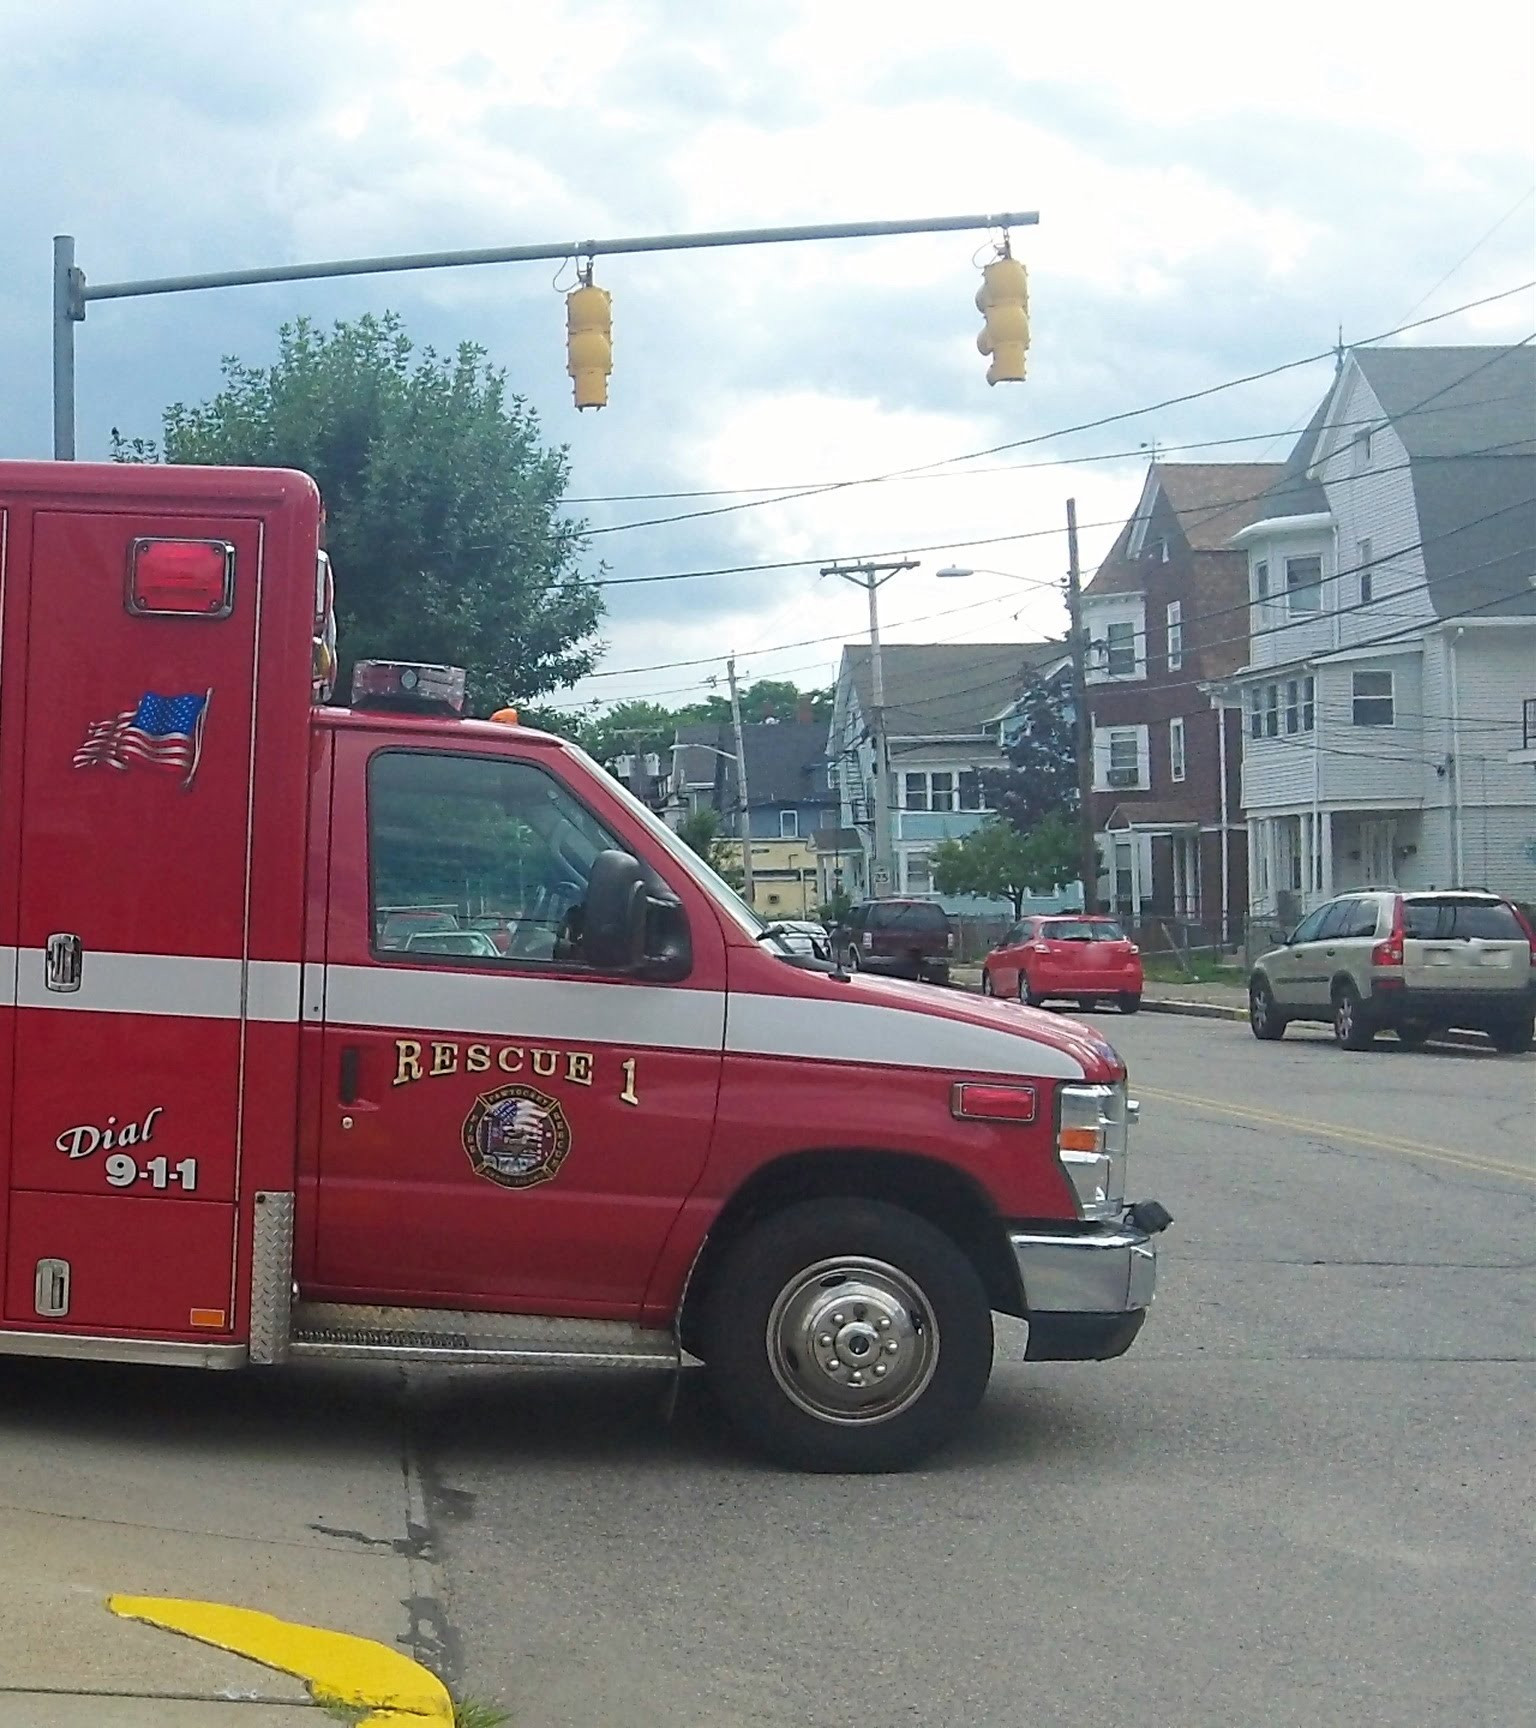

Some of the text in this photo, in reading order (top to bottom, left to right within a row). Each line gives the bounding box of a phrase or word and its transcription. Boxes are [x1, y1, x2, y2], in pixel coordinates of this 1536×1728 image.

[393, 1039, 639, 1105] RESCUE 1
[55, 1106, 163, 1159] Dial
[105, 1153, 196, 1190] 9-1-1
